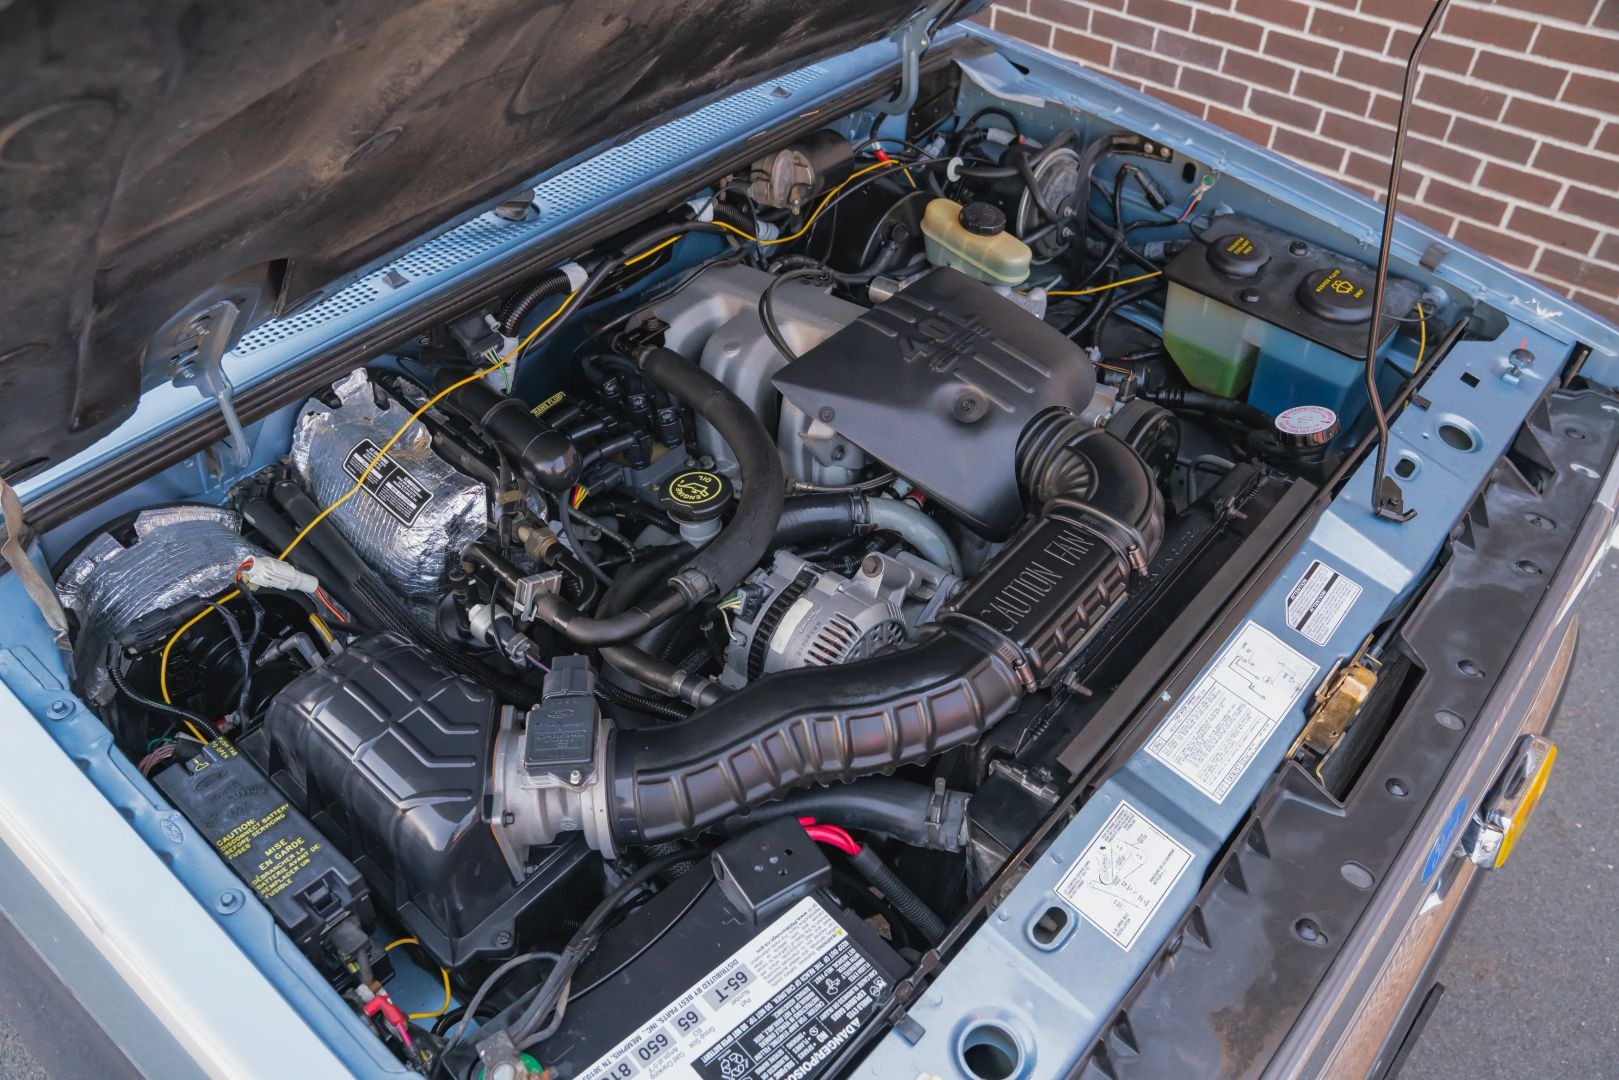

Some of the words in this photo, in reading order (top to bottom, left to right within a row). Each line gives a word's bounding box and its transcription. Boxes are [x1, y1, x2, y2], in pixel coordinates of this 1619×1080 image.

[675, 487, 701, 499] ENGINE
[979, 561, 1062, 632] CAUTION
[1044, 529, 1094, 564] FAN
[210, 740, 218, 748] TO
[215, 746, 230, 759] OPEN
[216, 735, 230, 748] PUSH
[227, 746, 238, 756] TAB
[215, 815, 256, 848] CAUTION:
[220, 821, 260, 852] DISCONNECT
[261, 801, 290, 824] BATTERY
[224, 835, 251, 856] BEFORE
[251, 811, 286, 838] SERVICING
[228, 842, 251, 861] FUSES
[258, 857, 273, 871] EN
[273, 835, 305, 861] GARDE
[263, 837, 288, 857] MISE
[250, 850, 295, 886] DÉBRANCHER
[295, 845, 305, 855] LA
[255, 865, 288, 891] BATTERIE
[288, 850, 309, 868] AVANT
[309, 842, 320, 852] DE
[260, 865, 300, 895] REMPLACER
[299, 857, 310, 867] UN
[264, 877, 293, 900] FUSIBLE
[827, 948, 839, 958] OUT
[836, 939, 849, 952] KEEP
[846, 947, 856, 956] GET
[813, 960, 823, 970] THE
[821, 955, 830, 964] OF
[831, 953, 849, 969] MEDICAL
[848, 952, 860, 963] WITH
[700, 958, 739, 990] DISTRIBUTED
[799, 966, 815, 982] REACH
[822, 965, 834, 977] HELP
[840, 956, 866, 979] IMMEDIATELY
[856, 961, 870, 975] FLUSH
[867, 969, 877, 978] CAN
[793, 978, 802, 987] OF
[812, 973, 825, 985] FAST.
[847, 971, 859, 982] EYES
[856, 975, 870, 988] CAUSE
[692, 986, 702, 996] BY
[711, 969, 749, 1003] 65-T
[771, 982, 796, 1005] CHILDREN.
[793, 985, 811, 1001] SERVICE
[837, 984, 859, 1004] BLINDNESS
[677, 993, 694, 1009] BEST
[763, 1001, 773, 1012] DO
[792, 994, 820, 1019] INSTRUCTIONS
[793, 1002, 801, 1010] OR
[831, 1001, 840, 1009] OR
[842, 988, 866, 1011] EXPLOSIVE
[855, 995, 873, 1011] SHIELD
[655, 1004, 679, 1025] PARTS,
[675, 1009, 700, 1032] 65
[746, 1015, 757, 1026] TIP.
[754, 1007, 767, 1019] NOT
[781, 1009, 792, 1020] NOT
[796, 1014, 807, 1025] FOR
[818, 1006, 834, 1020] INJURY
[829, 1006, 846, 1022] GASES
[845, 1006, 859, 1019] EYES
[730, 1027, 742, 1038] NOT
[739, 1022, 748, 1031] DO
[773, 1019, 790, 1035] VEHICLE
[719, 1033, 734, 1047] OPEN
[752, 1032, 764, 1044] SEEK
[785, 1032, 804, 1049] SMOKING
[815, 1030, 828, 1043] NO
[609, 1033, 642, 1061] MEMPHIS,
[636, 1031, 670, 1062] 650
[699, 1042, 723, 1064] BATTERY!
[753, 1044, 771, 1061] FOLLOW
[783, 1023, 855, 1080] DANGER/POISO
[791, 1037, 809, 1054] FLAMES
[796, 1043, 814, 1060] SPARKS
[600, 1057, 611, 1068] TN
[767, 1047, 784, 1064] SEVERE
[600, 1061, 632, 1080] 81
[753, 1059, 770, 1075] BURNS
